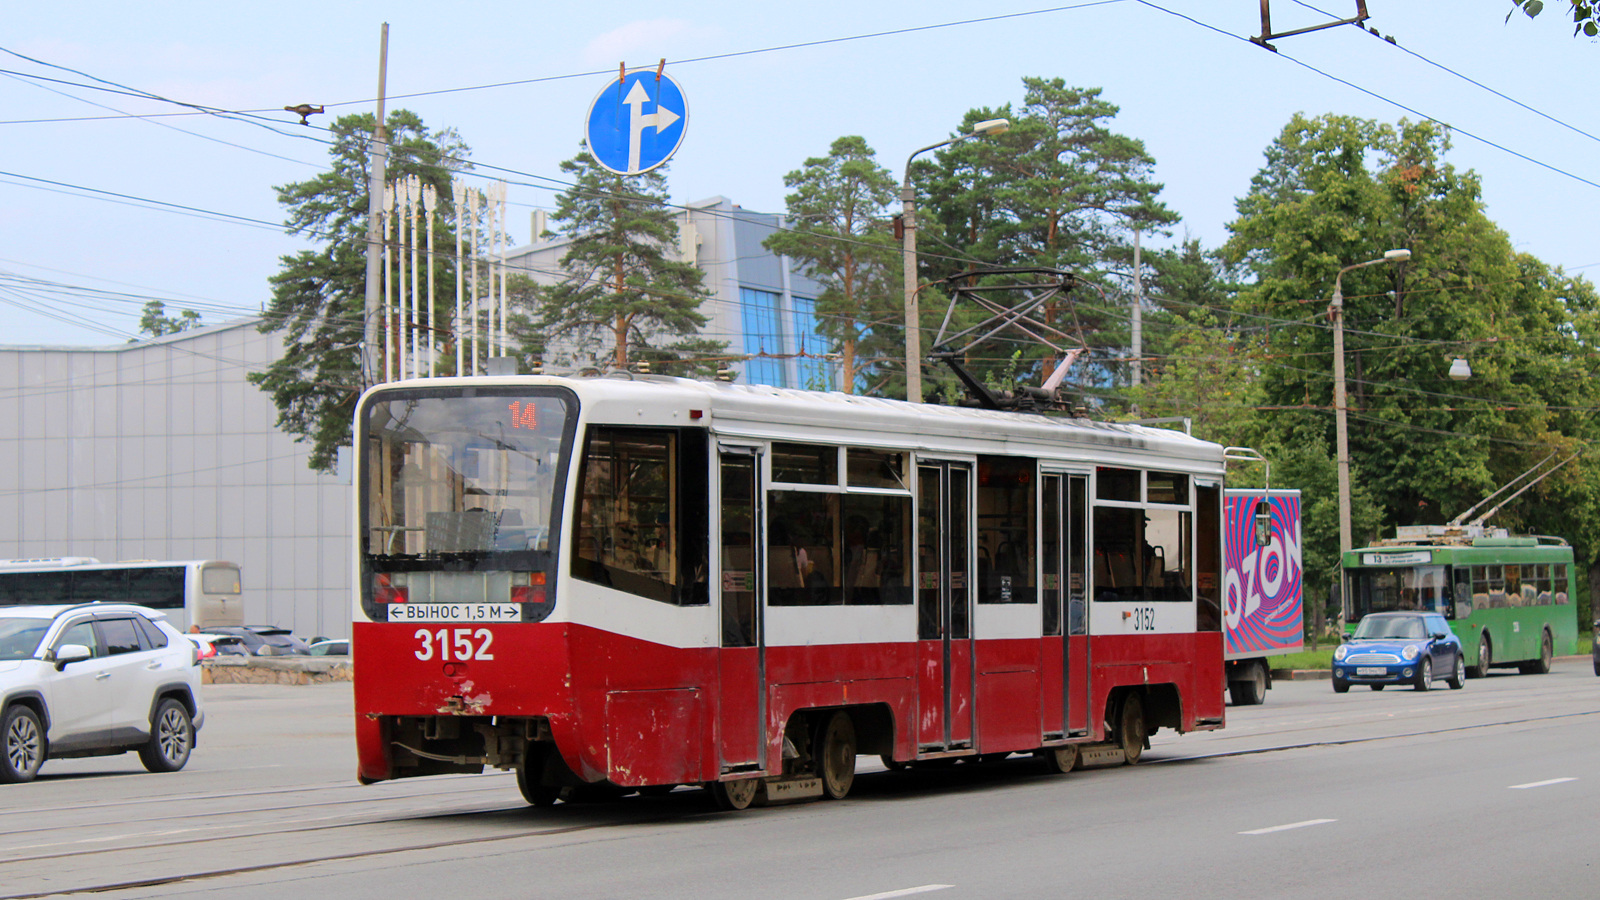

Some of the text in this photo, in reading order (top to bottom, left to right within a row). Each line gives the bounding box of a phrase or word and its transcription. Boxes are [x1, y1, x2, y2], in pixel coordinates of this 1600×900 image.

[509, 400, 537, 430] 14
[1373, 555, 1382, 563] 13
[1225, 519, 1302, 630] OZON
[406, 606, 502, 621] ВЫНОС 1,5 М
[1134, 607, 1155, 631] 3152
[414, 628, 494, 661] 3152
